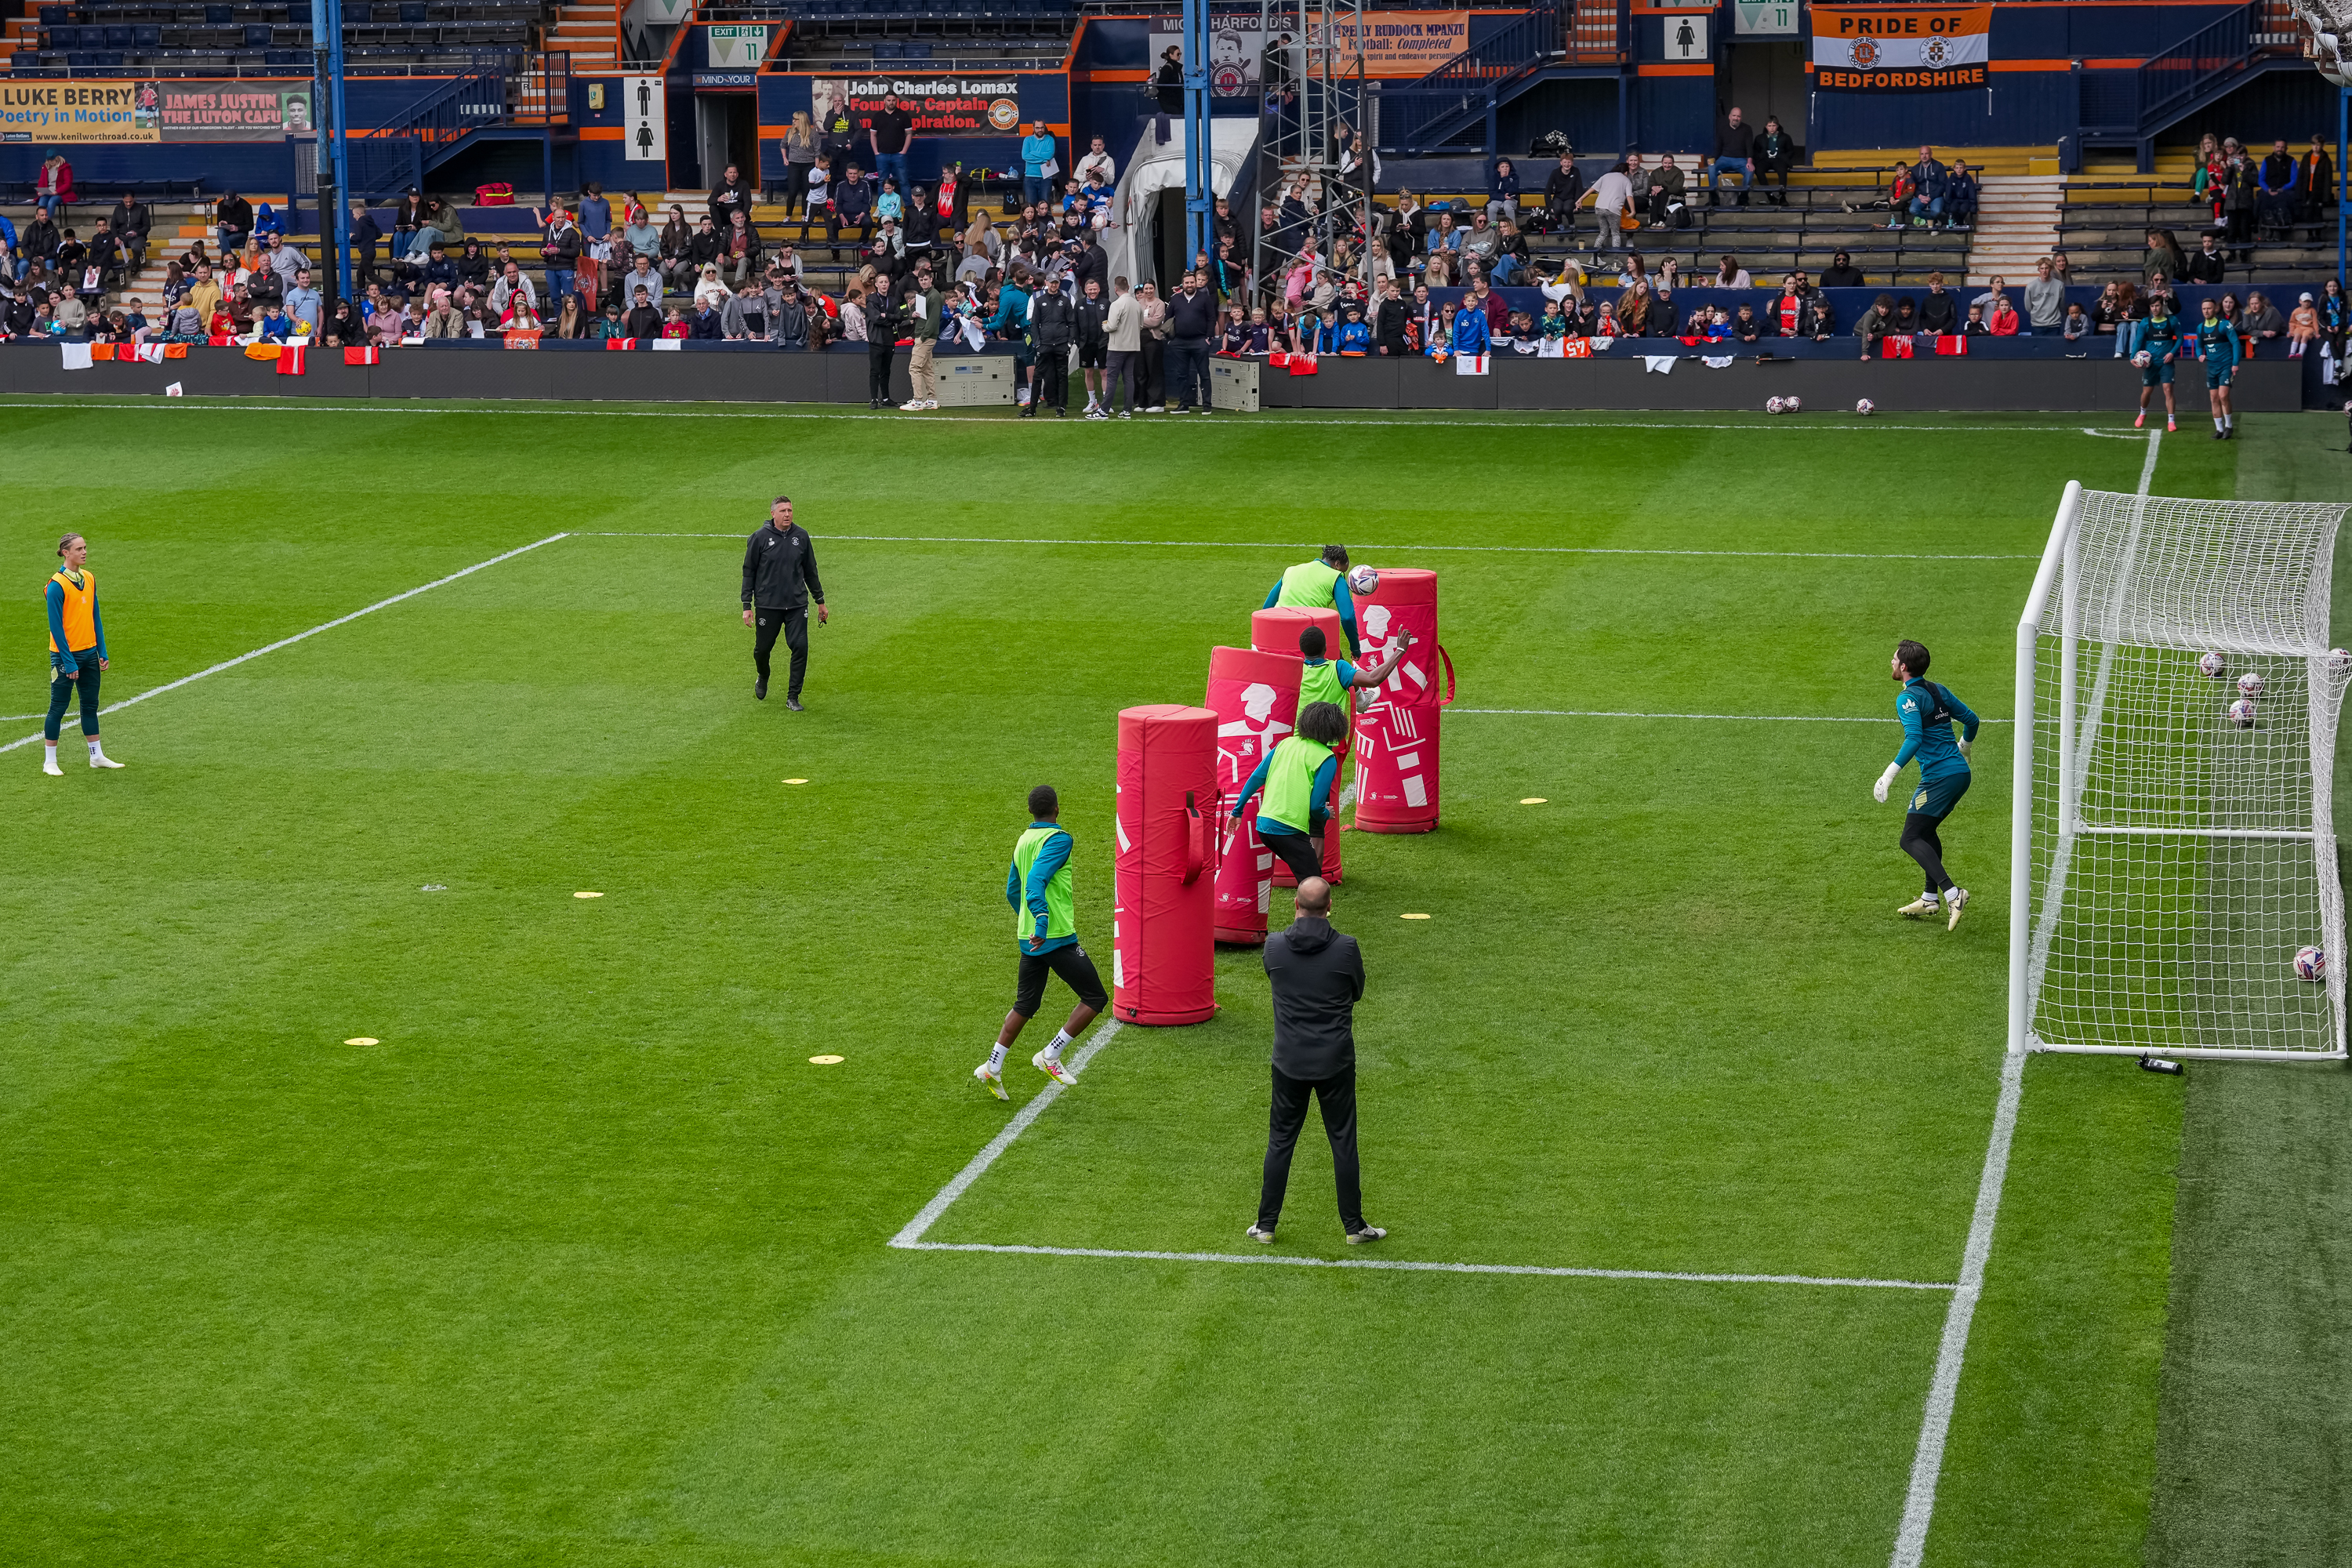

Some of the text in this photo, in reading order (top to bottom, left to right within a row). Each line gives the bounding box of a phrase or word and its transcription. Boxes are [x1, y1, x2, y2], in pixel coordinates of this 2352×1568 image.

[1163, 19, 1184, 31] MIC
[1776, 9, 1788, 27] 11
[1840, 17, 1962, 34] PRIDE OF
[1374, 24, 1423, 37] RUDDOCK
[1426, 24, 1465, 36] MPANZU
[1397, 38, 1452, 51] Completed
[1850, 37, 1865, 50] LUTON
[1923, 36, 1949, 47] LUTON TOWN
[746, 43, 757, 60] 11
[1367, 53, 1383, 61] spirit
[702, 75, 724, 84] MIND
[1819, 68, 1984, 88] BEDFORDSHIRE
[849, 80, 1018, 95] John Charles Lomax
[4, 88, 132, 106] LUKE BERRY
[165, 93, 277, 110] JAMES JUSTIN
[850, 96, 988, 114] Fouer, Captain
[0, 107, 132, 126] Poetry in Motion
[162, 110, 281, 124] THE LUTON CAFU
[911, 114, 980, 131] piration.
[36, 132, 154, 141] www.kenilworthroad.co.uk
[1566, 339, 1585, 358] 45
[1934, 712, 1949, 720] CATAPULT
